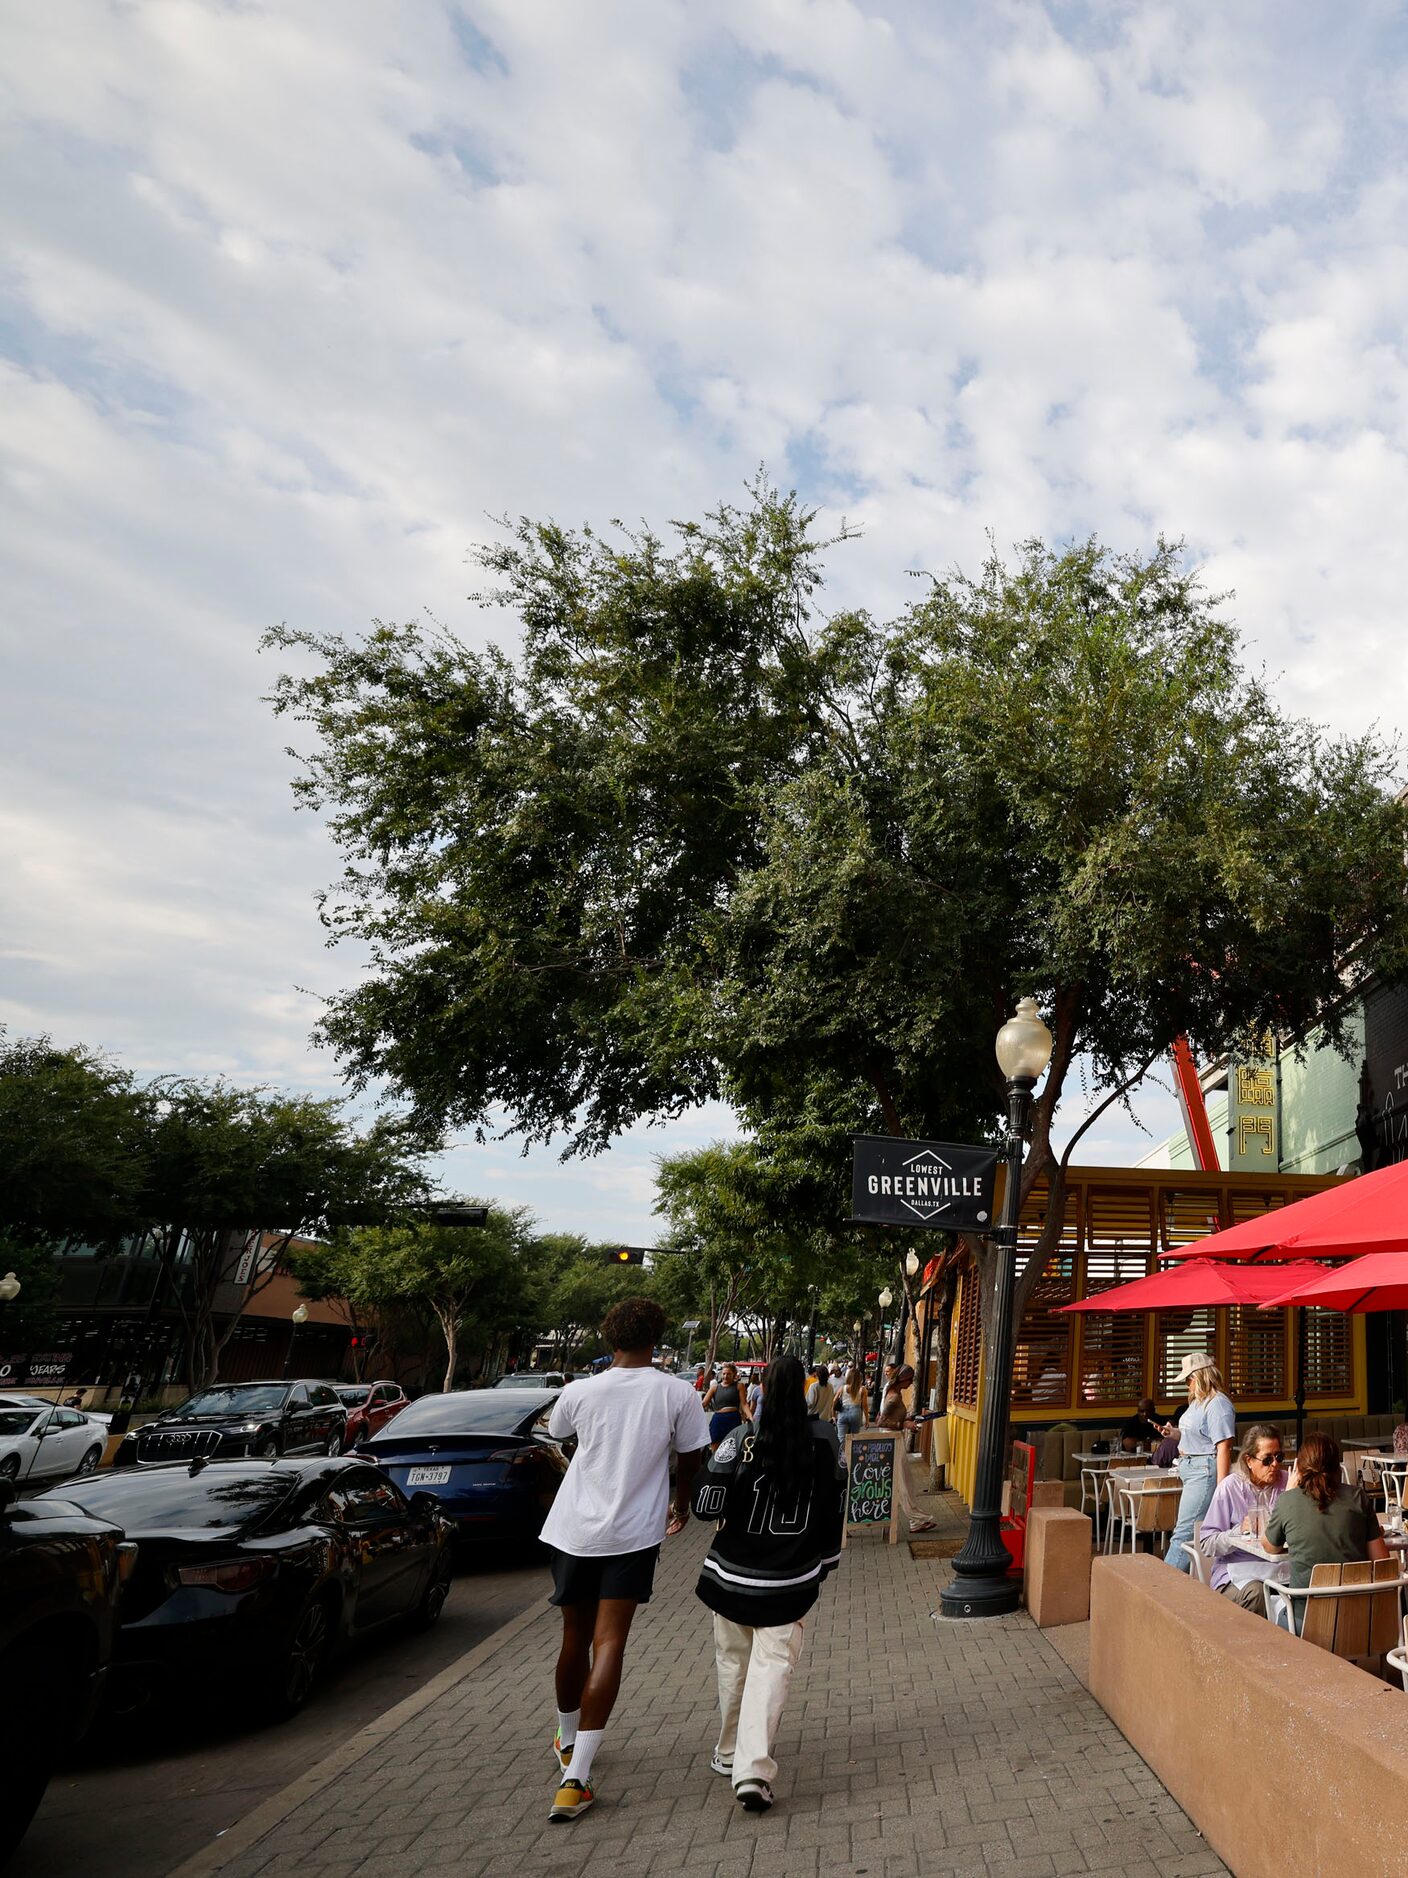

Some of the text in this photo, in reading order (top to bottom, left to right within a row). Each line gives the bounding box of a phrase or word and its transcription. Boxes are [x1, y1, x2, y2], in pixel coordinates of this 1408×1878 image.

[910, 1163, 943, 1175] LOWEST
[867, 1175, 982, 1196] GREENVILLE
[696, 1484, 727, 1514] 10
